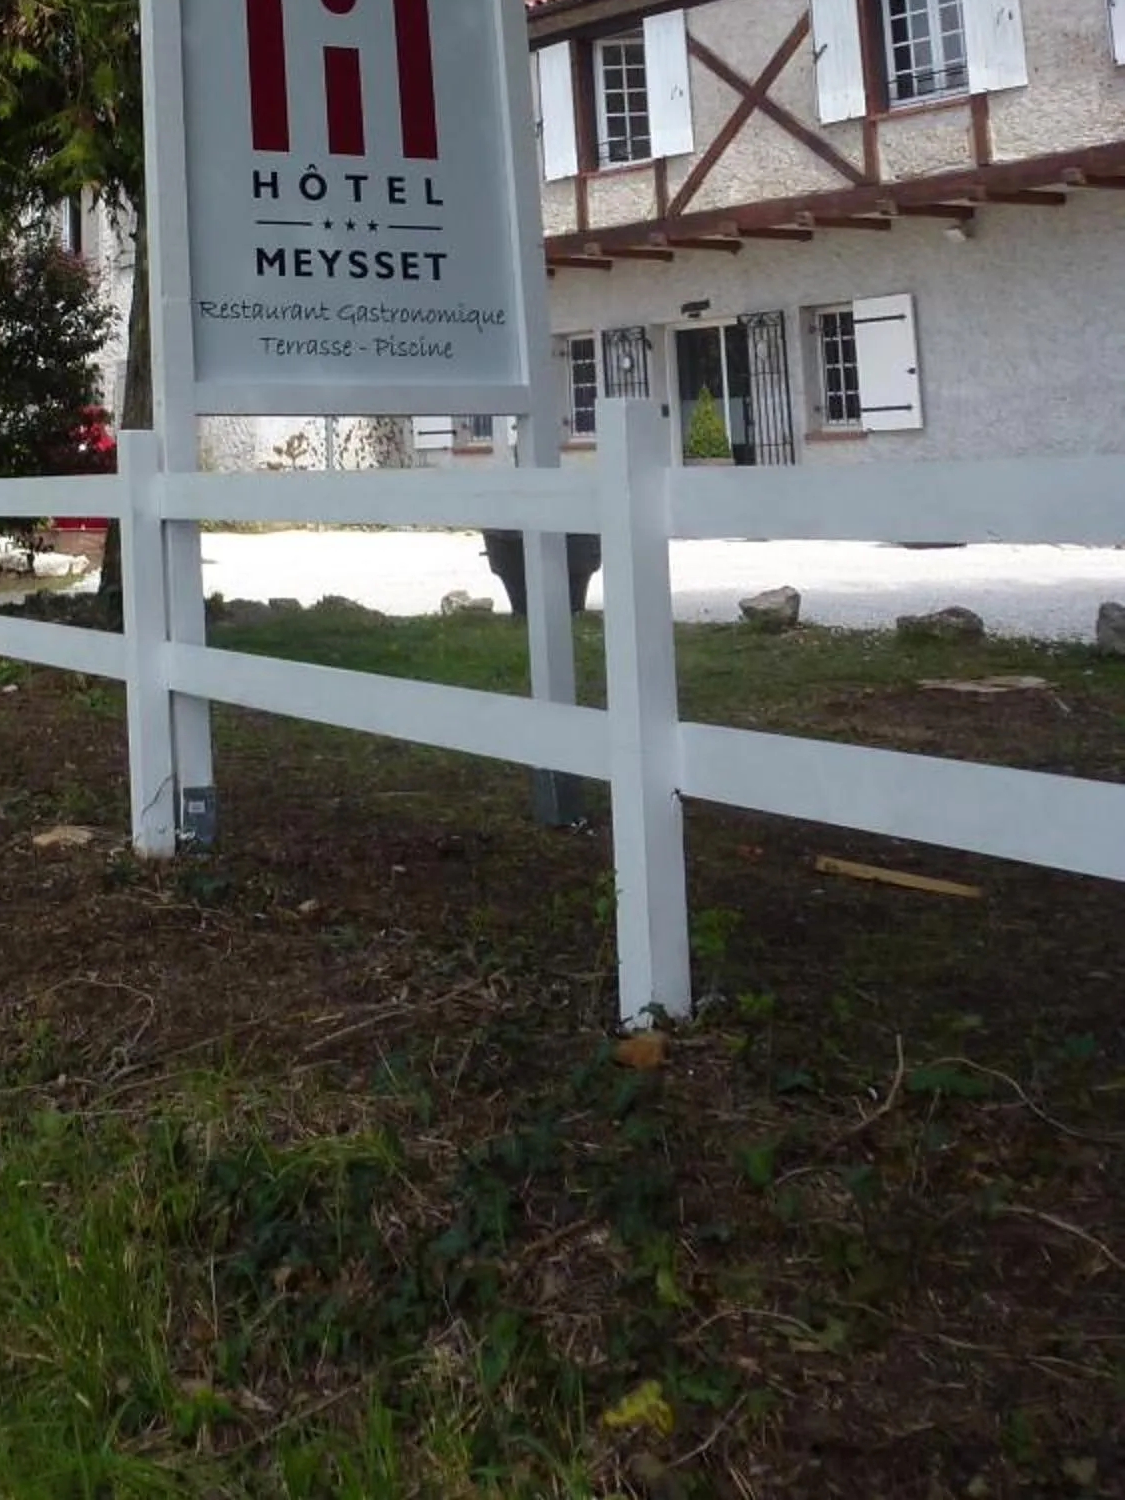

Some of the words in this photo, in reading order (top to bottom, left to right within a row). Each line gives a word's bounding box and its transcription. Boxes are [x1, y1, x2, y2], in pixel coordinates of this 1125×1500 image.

[252, 164, 444, 205] HÔTEL
[255, 247, 448, 281] MEYSSET
[198, 300, 330, 322] Restaurant
[336, 302, 506, 332] Gastronomique
[259, 336, 353, 357] Terrasse
[374, 336, 455, 359] Piscine
